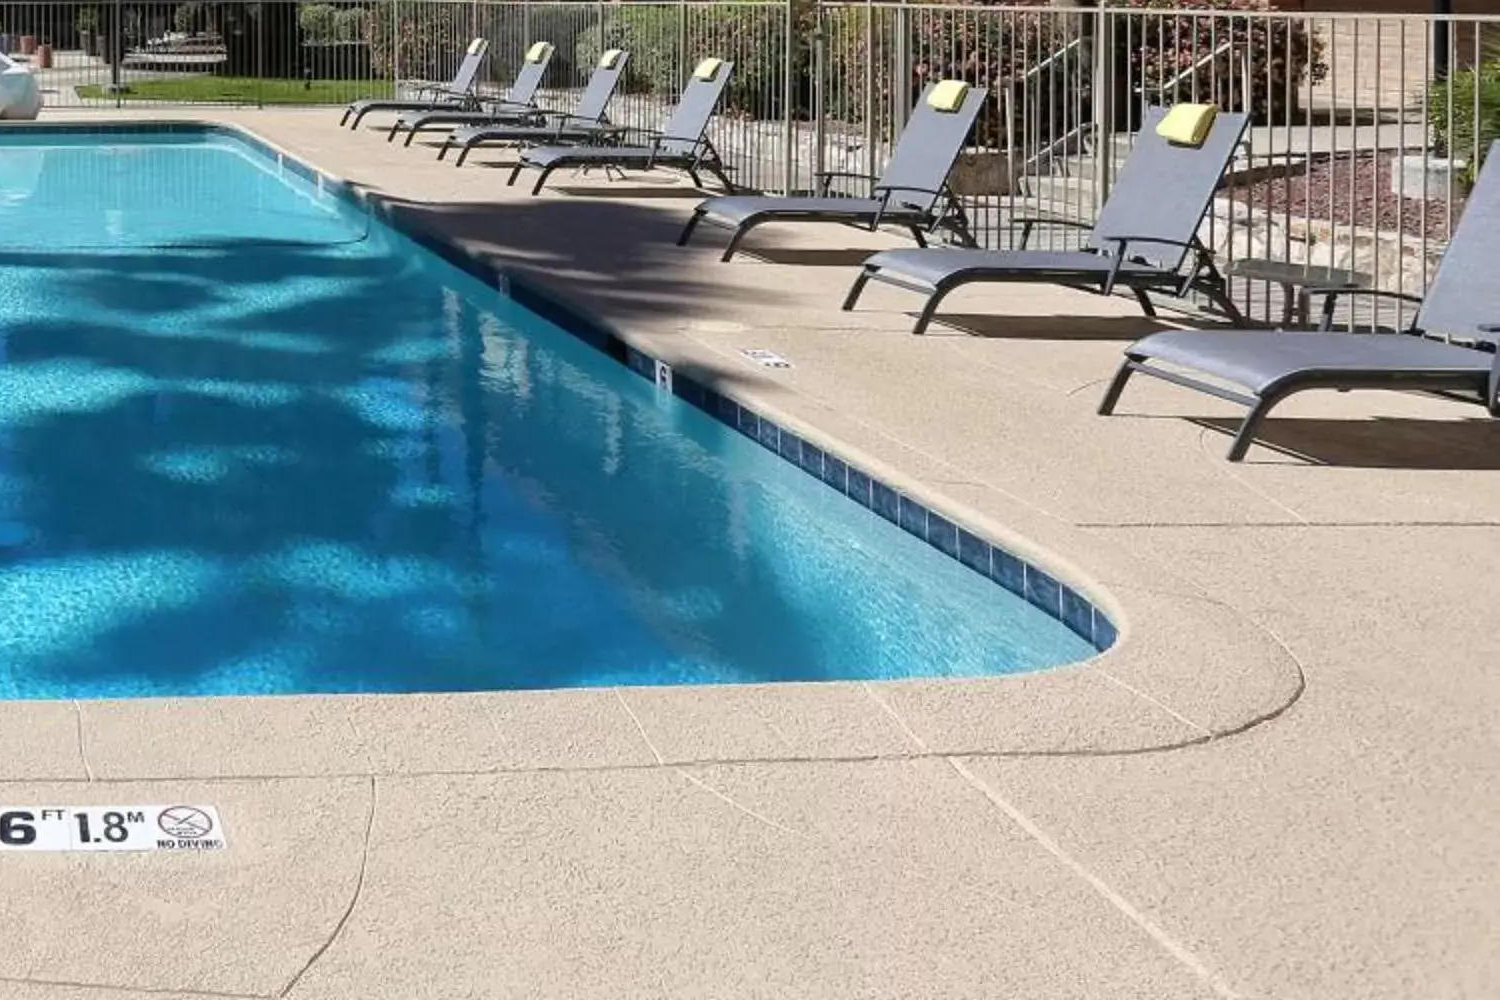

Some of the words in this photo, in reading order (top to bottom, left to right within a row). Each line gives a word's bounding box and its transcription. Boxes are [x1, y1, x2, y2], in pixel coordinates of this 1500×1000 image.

[0, 811, 36, 845] 6
[41, 809, 65, 821] FT
[74, 811, 129, 843] 1.8
[157, 839, 175, 849] NO
[177, 839, 223, 849] DIVING
